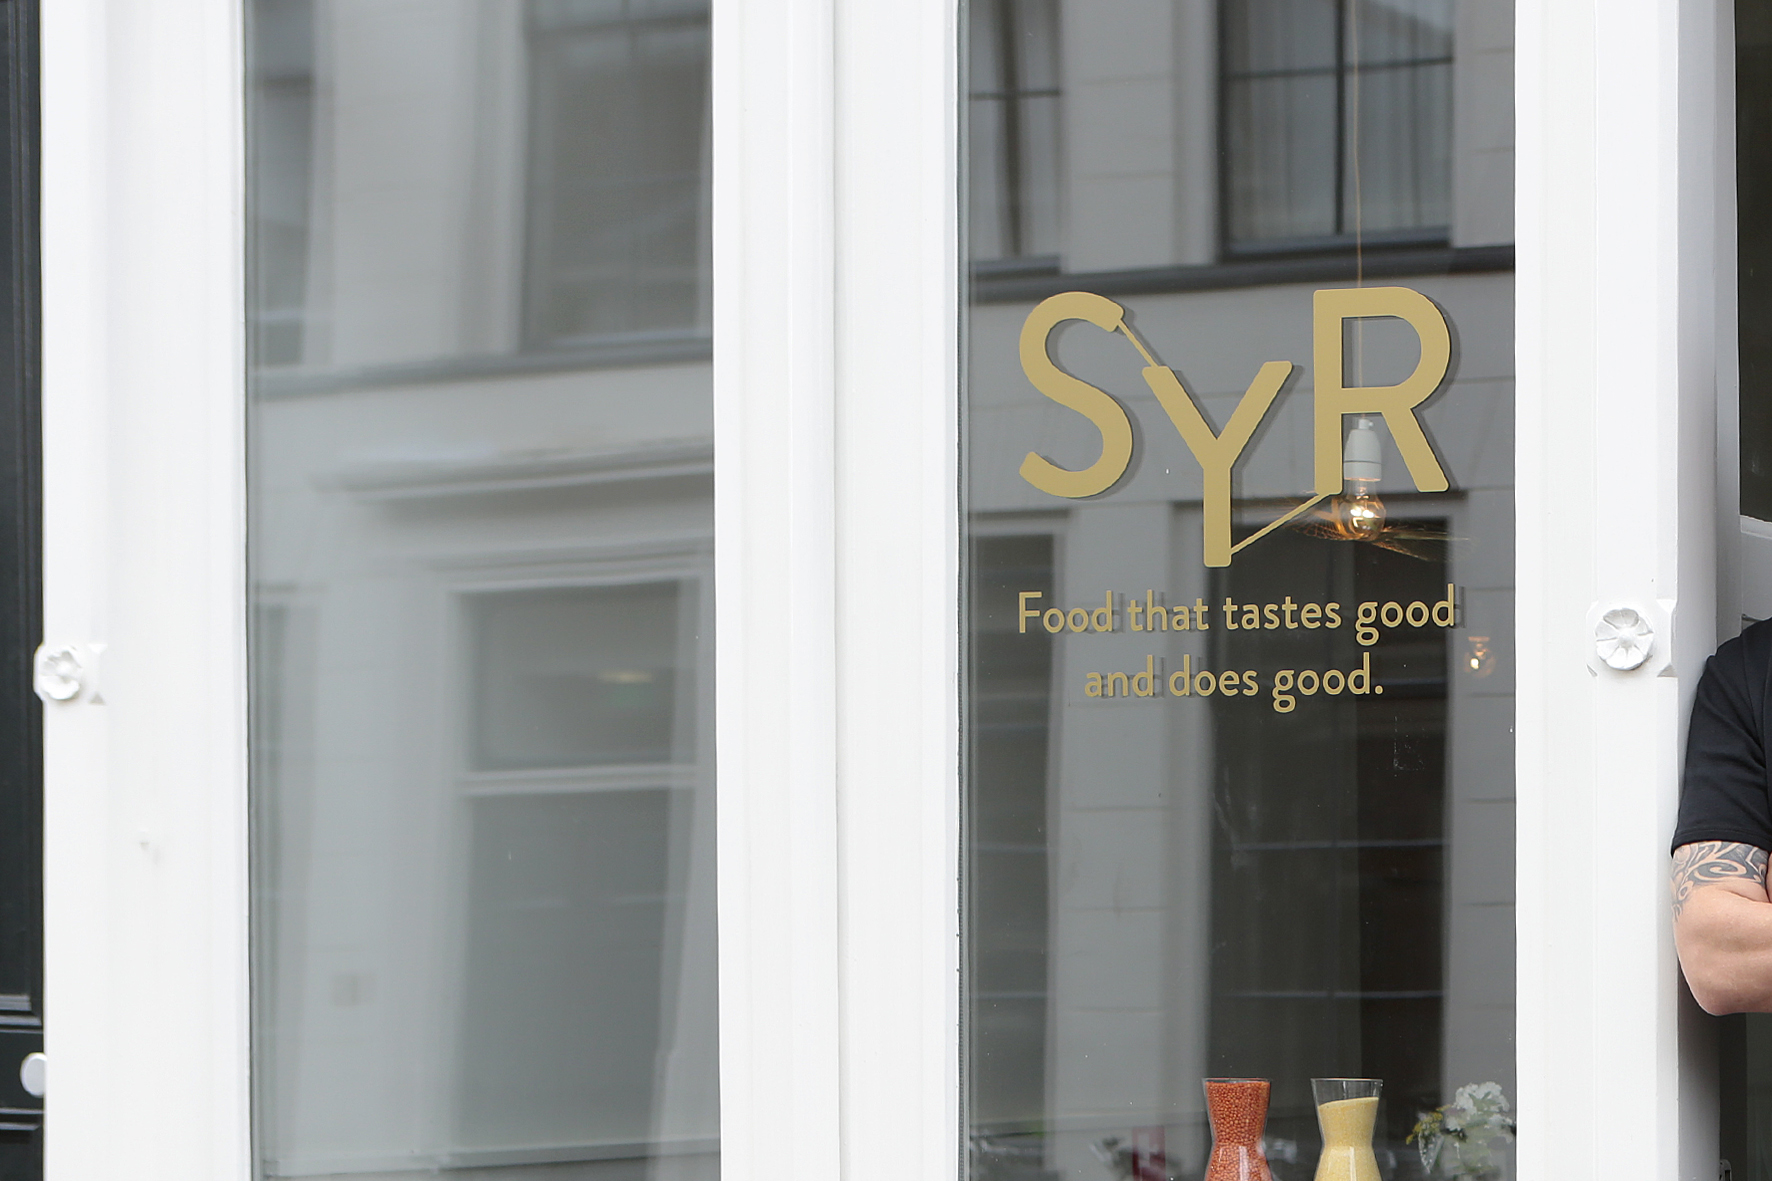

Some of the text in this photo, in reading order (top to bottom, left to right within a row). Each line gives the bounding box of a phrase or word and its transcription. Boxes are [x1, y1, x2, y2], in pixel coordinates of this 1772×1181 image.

[1019, 286, 1451, 567] SYR
[1018, 583, 1456, 646] Food that tastes good
[1084, 651, 1384, 713] and does good.
